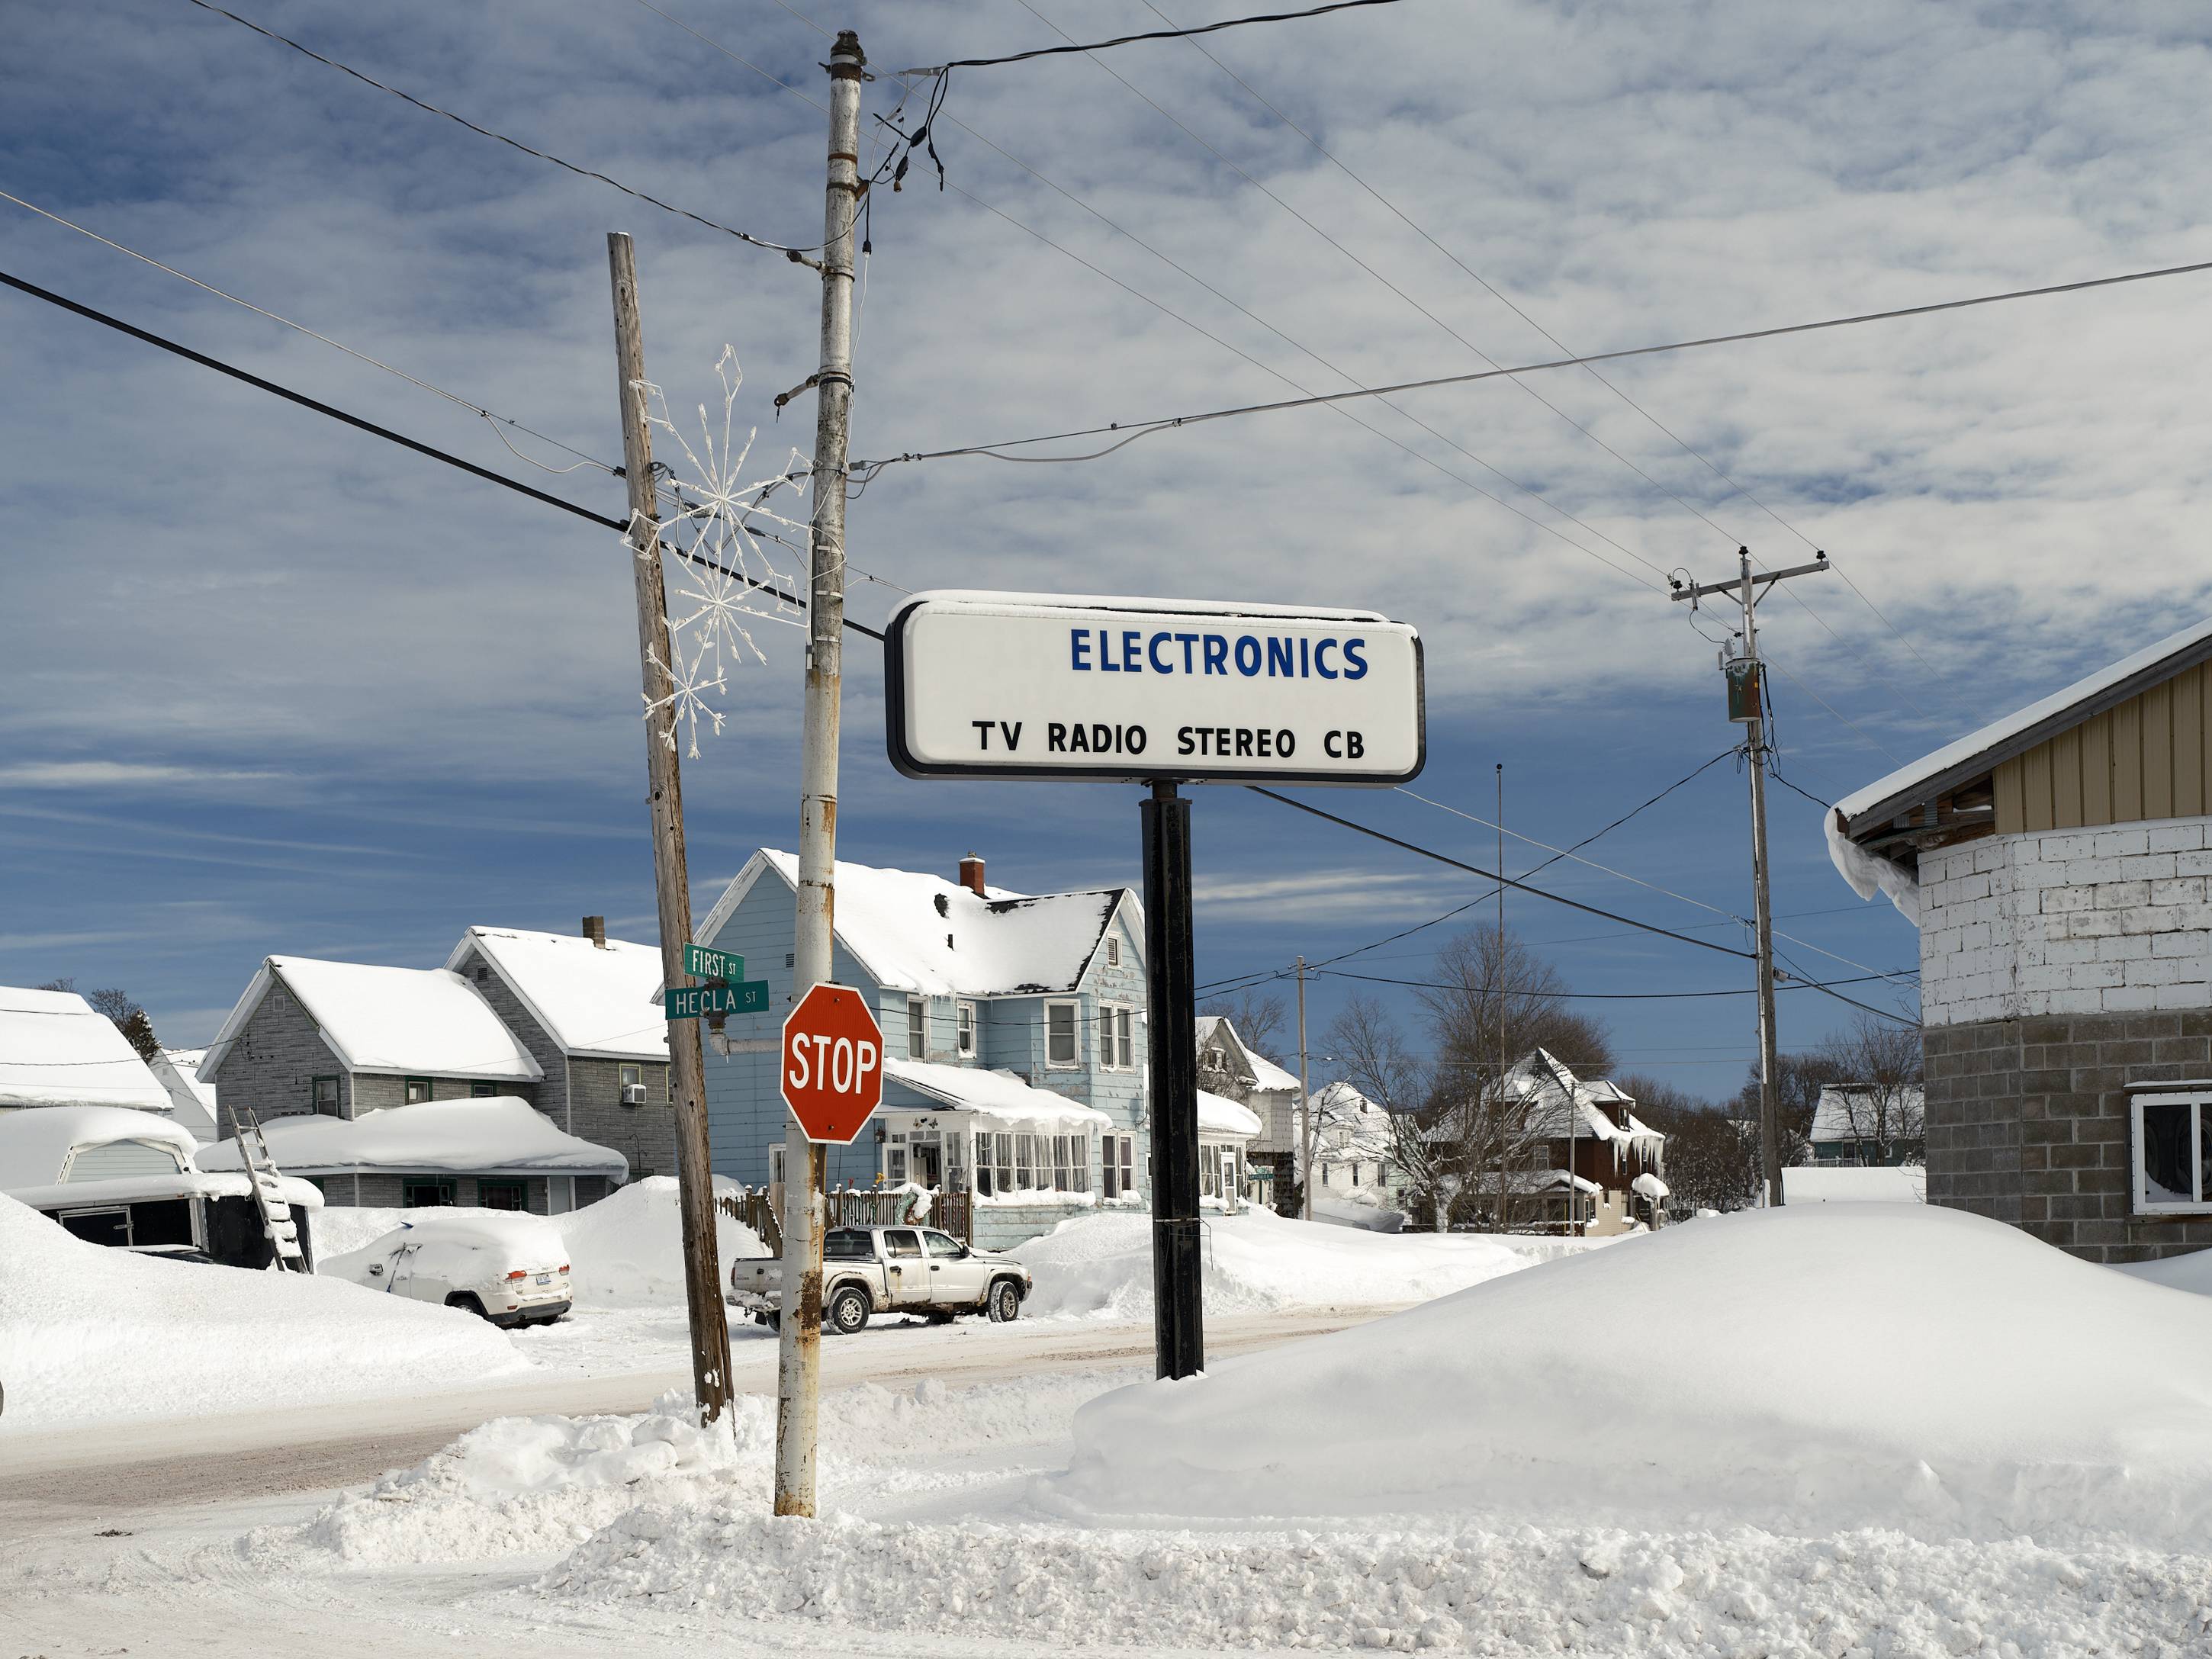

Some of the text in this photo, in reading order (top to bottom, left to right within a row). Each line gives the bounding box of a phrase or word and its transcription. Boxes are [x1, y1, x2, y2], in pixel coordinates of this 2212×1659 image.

[1070, 629, 1369, 680] ELECTRONICS
[973, 720, 1365, 759] TV RADIO STEREO CB
[693, 949, 736, 978] FIRST ST
[676, 989, 756, 1014] HECLA ST
[789, 1032, 877, 1095] STOP
